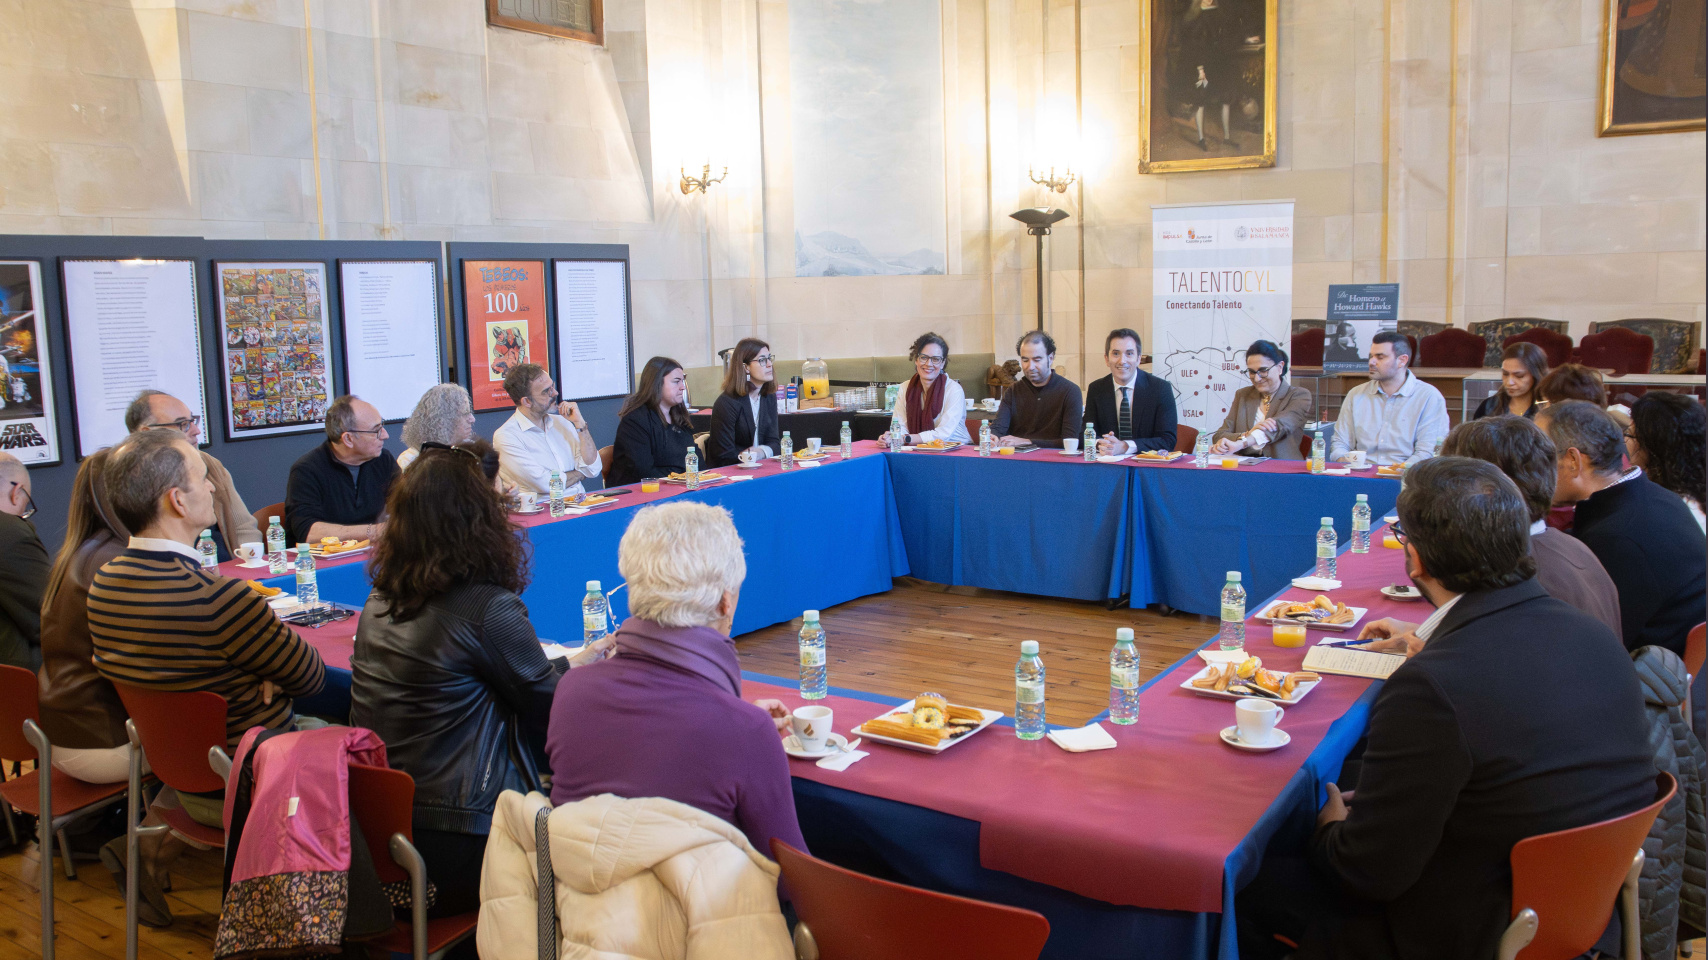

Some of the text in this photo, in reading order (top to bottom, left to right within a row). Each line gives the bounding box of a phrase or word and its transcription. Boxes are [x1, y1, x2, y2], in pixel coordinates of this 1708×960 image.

[479, 266, 529, 283] TEBEOS:
[1169, 270, 1276, 293] TALENTOCYL
[483, 292, 518, 313] 100
[1349, 294, 1380, 302] Homero
[1166, 299, 1242, 310] Conectando Talento
[1334, 301, 1392, 311] Howard Hawks
[1222, 362, 1236, 371] UBU
[1181, 369, 1193, 378] ULE
[1213, 383, 1227, 392] UVA
[1182, 409, 1199, 418] USAL
[2, 422, 39, 435] STAR
[0, 432, 48, 450] WARS
